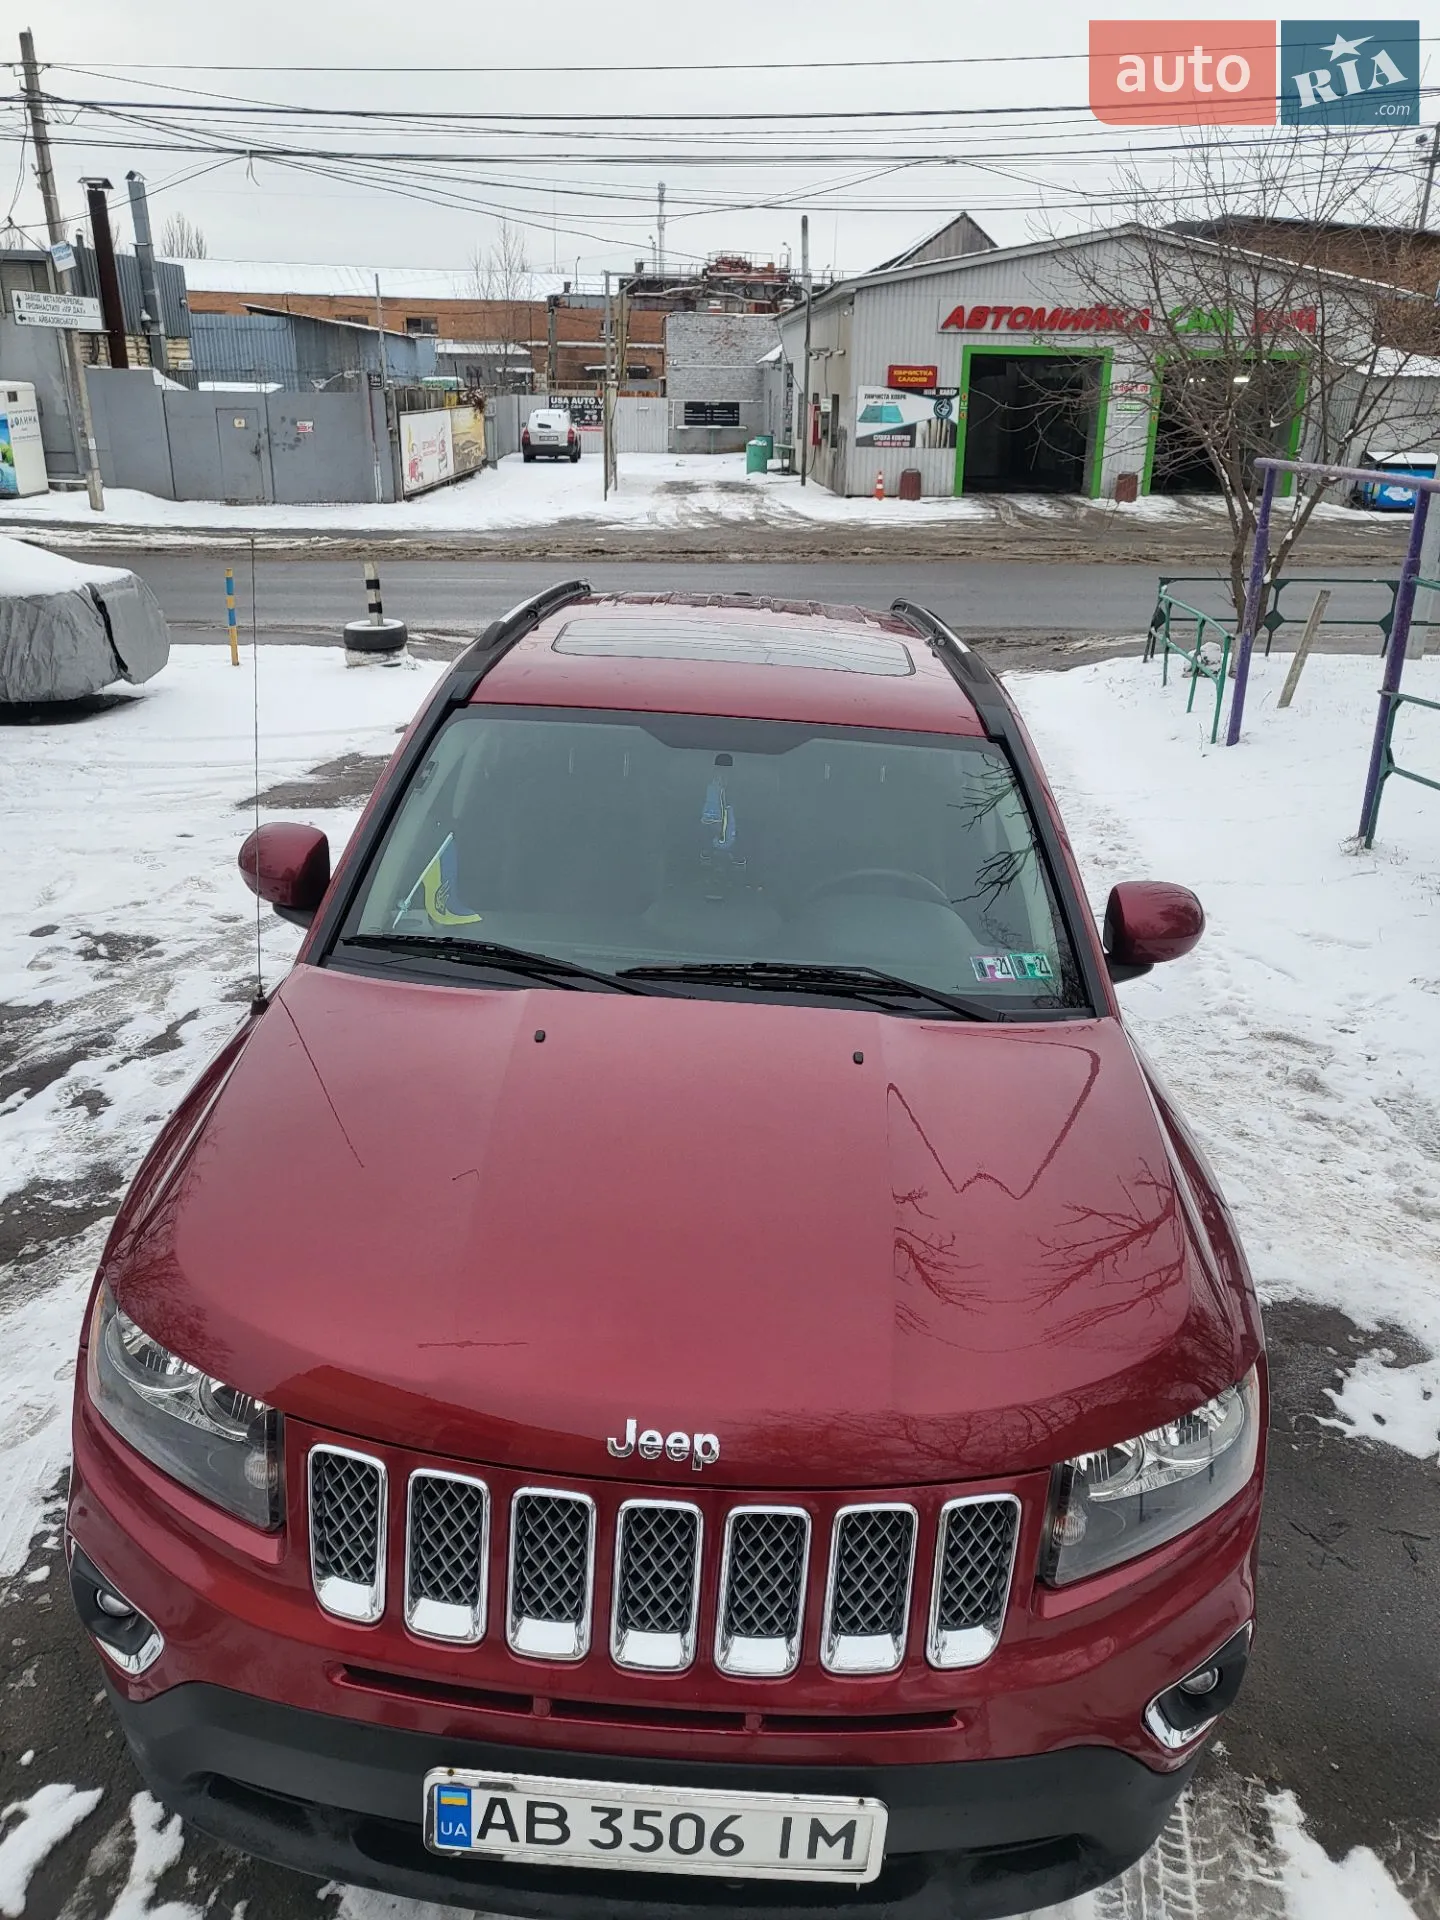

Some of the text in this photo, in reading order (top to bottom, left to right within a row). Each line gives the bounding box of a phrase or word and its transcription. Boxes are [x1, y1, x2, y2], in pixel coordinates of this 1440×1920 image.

[550, 397, 570, 405] USA
[571, 397, 596, 405] AUTO
[607, 1417, 720, 1471] Jeep
[440, 1797, 858, 1860] UA AB 3506 IM
